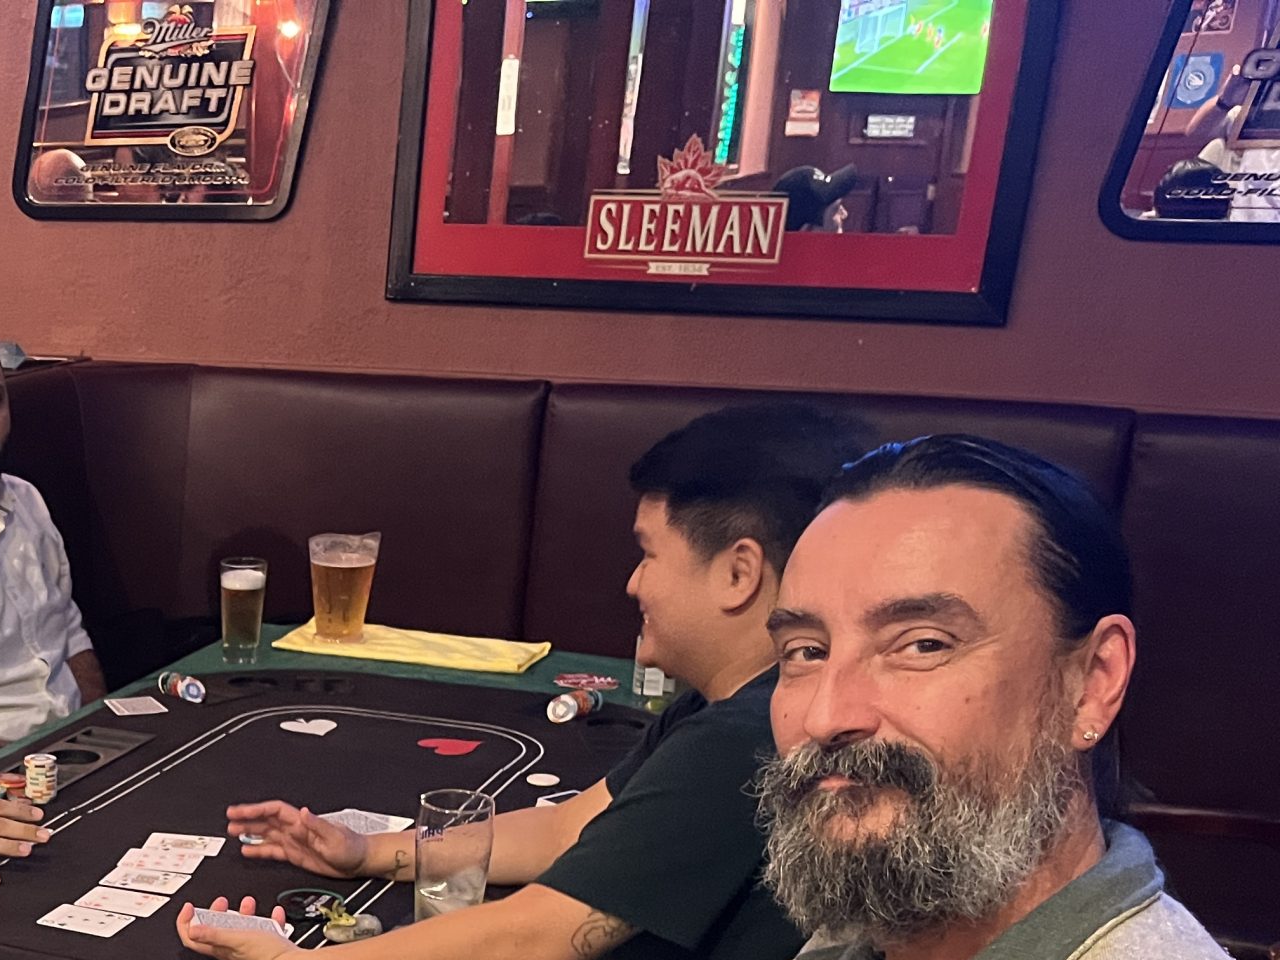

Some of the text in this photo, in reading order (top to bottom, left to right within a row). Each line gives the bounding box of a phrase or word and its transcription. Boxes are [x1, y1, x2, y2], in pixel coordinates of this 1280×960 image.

[142, 18, 213, 46] Miller
[85, 60, 255, 92] GENUINE
[101, 88, 230, 117] DRAFT
[596, 202, 777, 255] SLEEMAN
